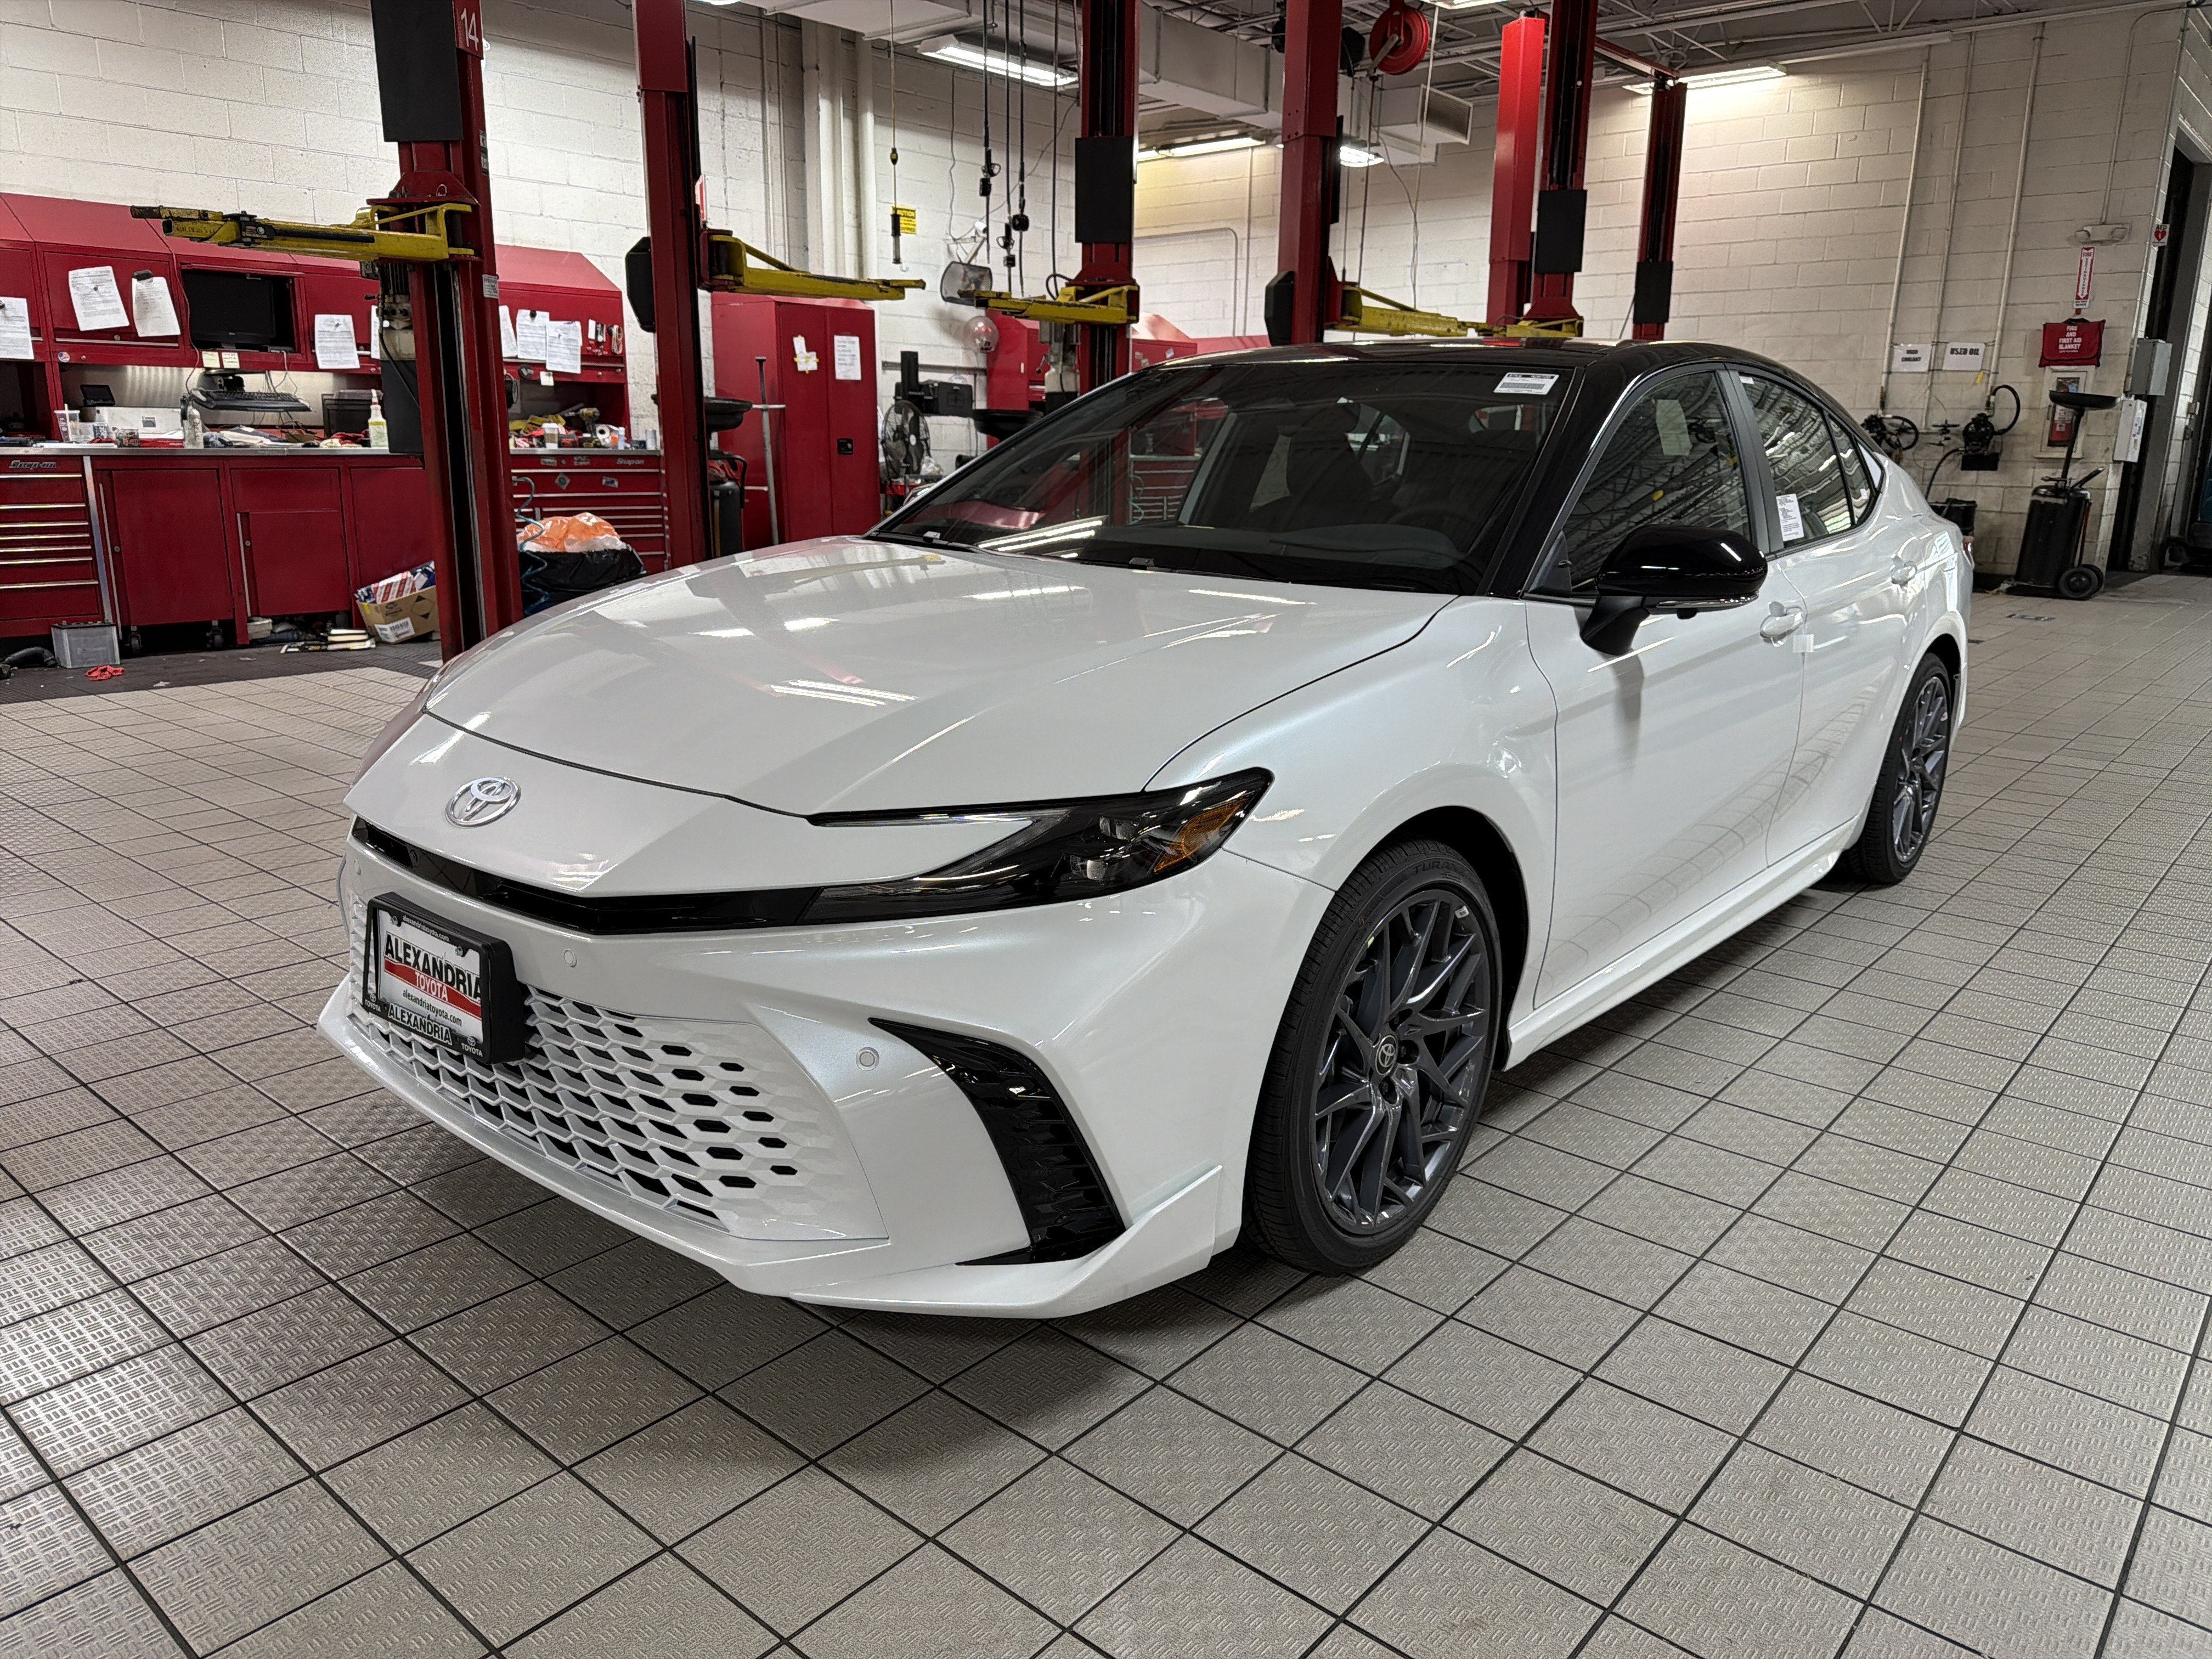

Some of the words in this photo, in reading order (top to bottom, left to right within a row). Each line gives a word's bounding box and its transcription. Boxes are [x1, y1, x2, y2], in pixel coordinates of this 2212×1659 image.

[461, 8, 479, 52] 14
[1950, 347, 1968, 356] USED
[402, 915, 450, 943] alexandriatoyota.com
[385, 934, 481, 1001] ALEXANDRIA
[415, 971, 448, 1001] TOYOTA
[364, 999, 381, 1013] TOYOTA
[403, 989, 462, 1026] alexandriatoyota.com
[388, 1003, 453, 1046] ALEXANDRIA
[461, 1043, 483, 1058] TOYOTA
